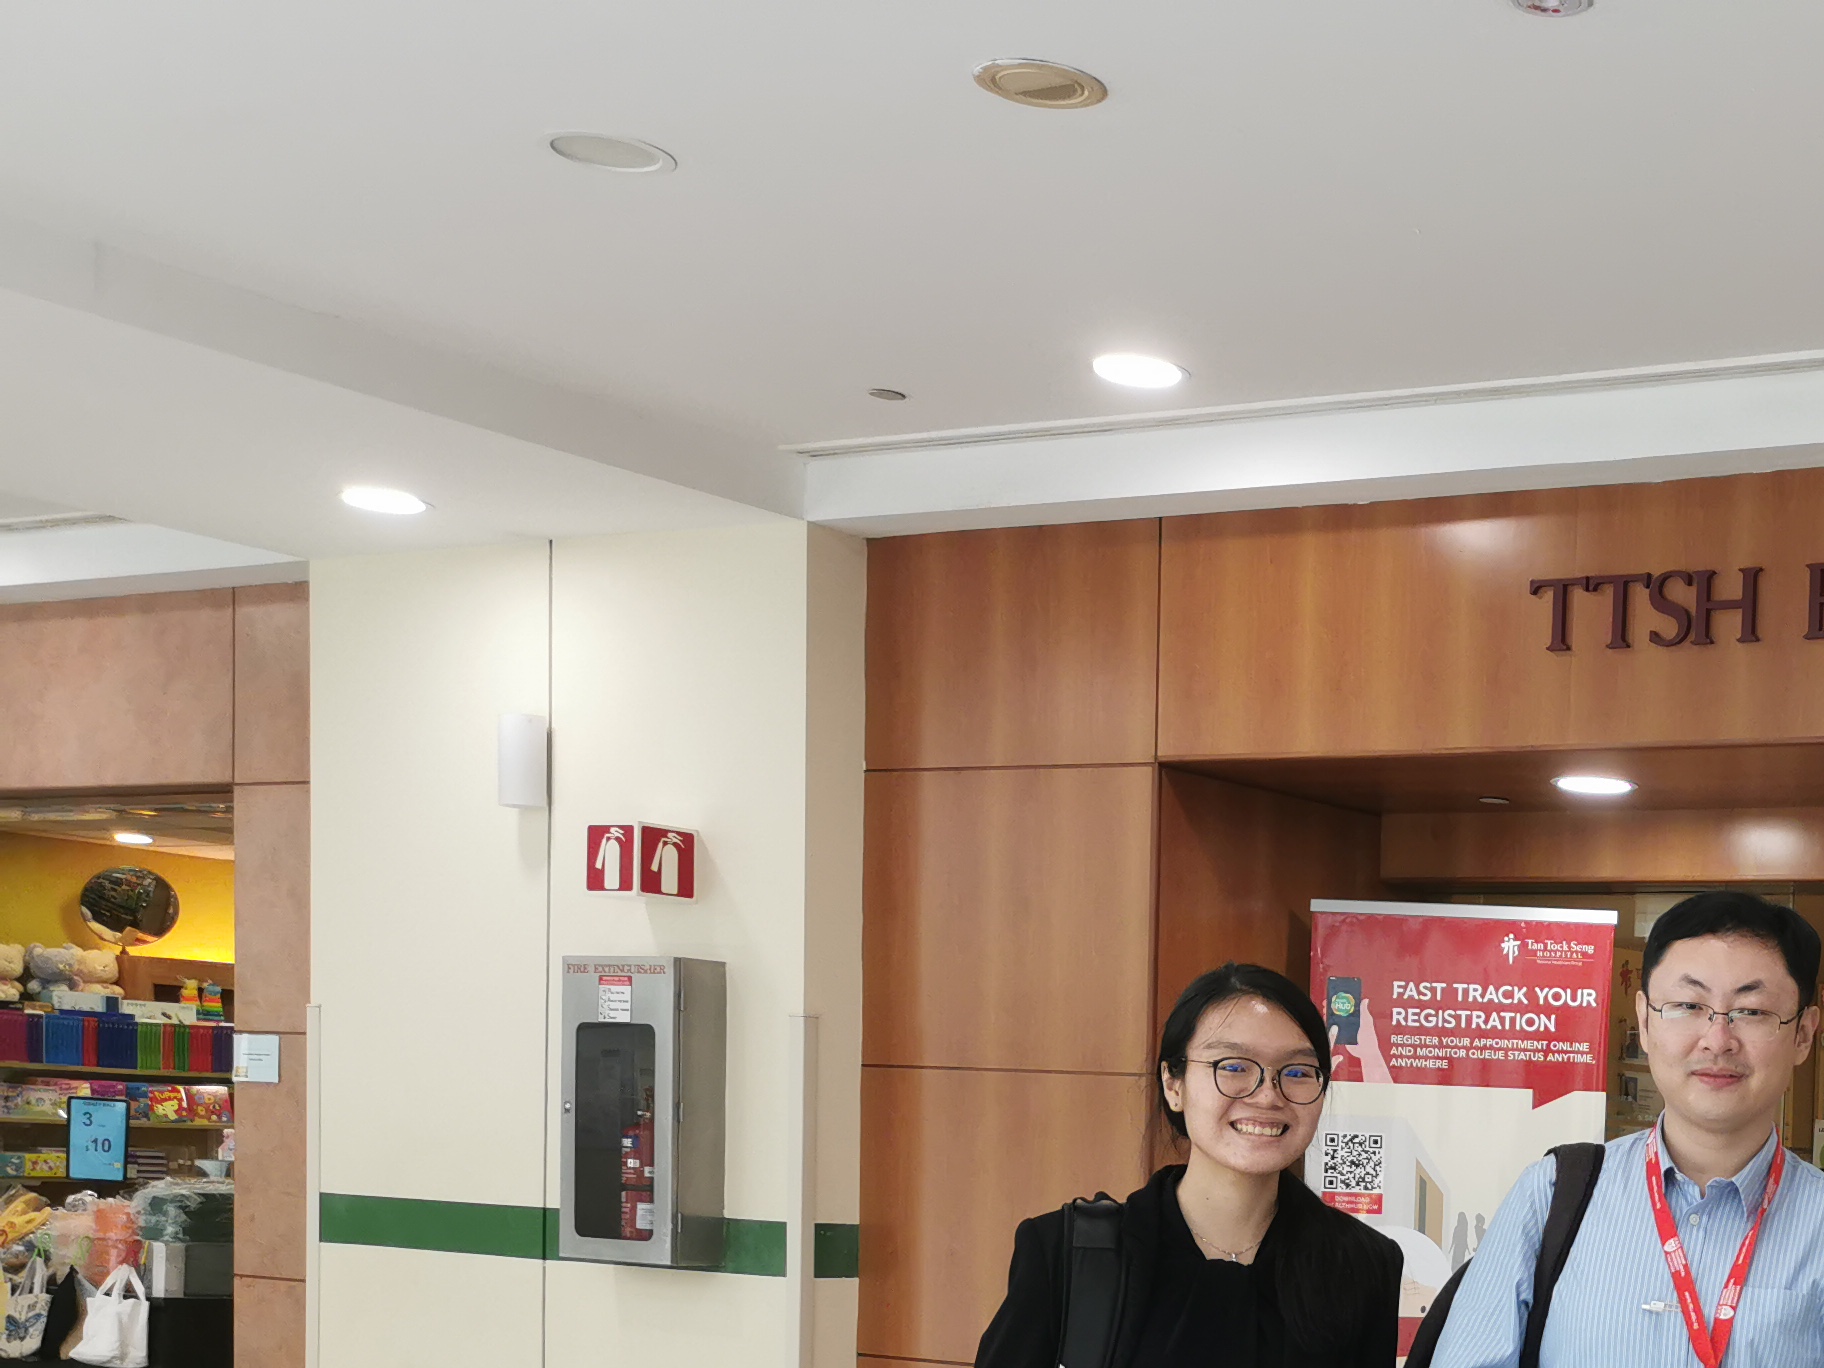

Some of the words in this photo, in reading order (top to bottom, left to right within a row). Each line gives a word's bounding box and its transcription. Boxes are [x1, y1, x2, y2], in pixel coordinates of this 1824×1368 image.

[1529, 565, 1763, 653] TTSH
[1525, 939, 1544, 950] Tan
[1545, 940, 1568, 951] Tock
[1570, 941, 1595, 954] Seng
[1537, 950, 1583, 959] HOSPITAL
[566, 963, 589, 974] FIRE
[1392, 980, 1447, 1001] FAST
[1453, 983, 1528, 1005] TRACK
[1534, 987, 1597, 1007] YOUR
[1335, 1002, 1351, 1010] Hub
[1391, 1007, 1556, 1033] REGISTRATION
[1390, 1035, 1439, 1046] REGISTER
[1441, 1037, 1470, 1047] YOUR
[1473, 1038, 1547, 1050] APPOINTMENT
[1550, 1041, 1589, 1051] ONLINE
[1390, 1046, 1414, 1056] AND
[1416, 1047, 1467, 1058] MONITOR
[1469, 1049, 1505, 1060] QUEUE
[1507, 1050, 1544, 1061] STATUS
[1547, 1053, 1596, 1064] ANYTIME,
[1390, 1058, 1449, 1069] ANYWHERE
[82, 1111, 93, 1126] 3
